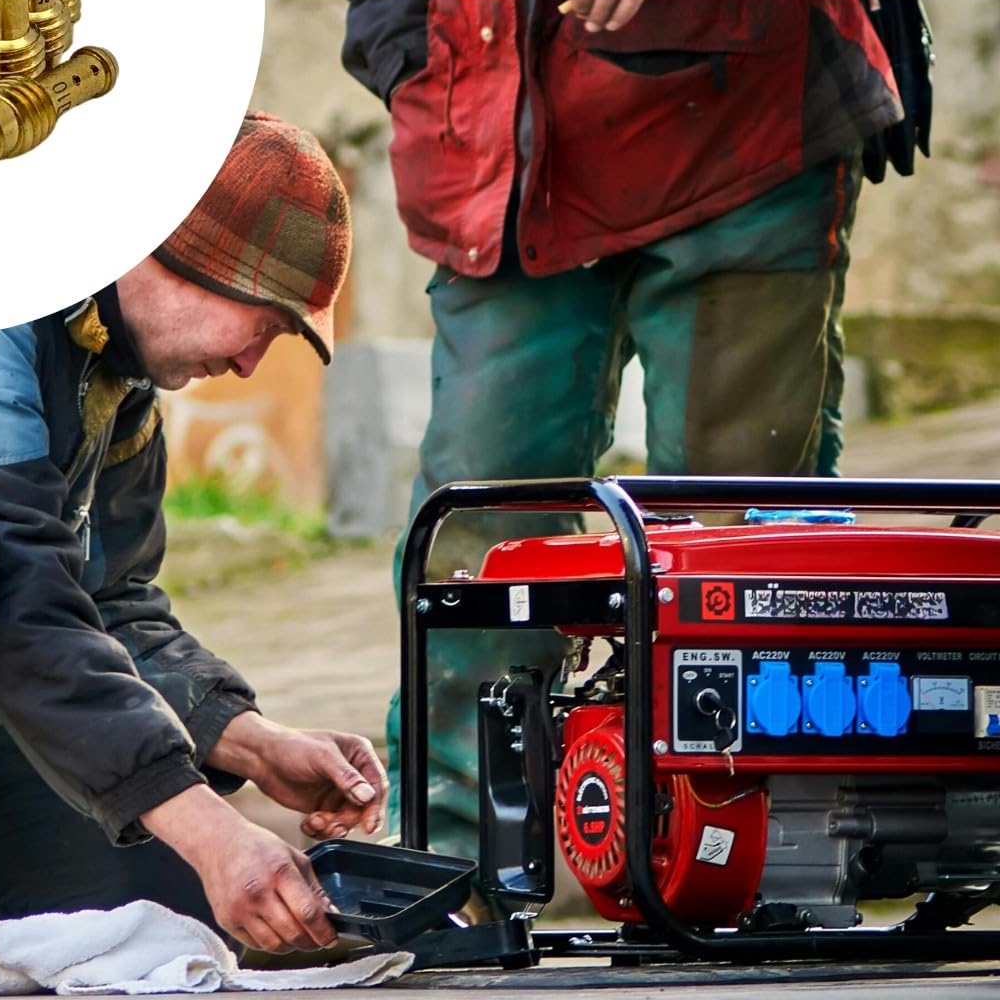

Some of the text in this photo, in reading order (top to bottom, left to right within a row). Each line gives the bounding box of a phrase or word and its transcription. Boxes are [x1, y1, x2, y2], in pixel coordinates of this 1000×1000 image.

[682, 651, 736, 662] ENG.SW.
[752, 651, 790, 660] AC220V
[808, 651, 846, 660] AC220V
[862, 651, 900, 661] AC220V
